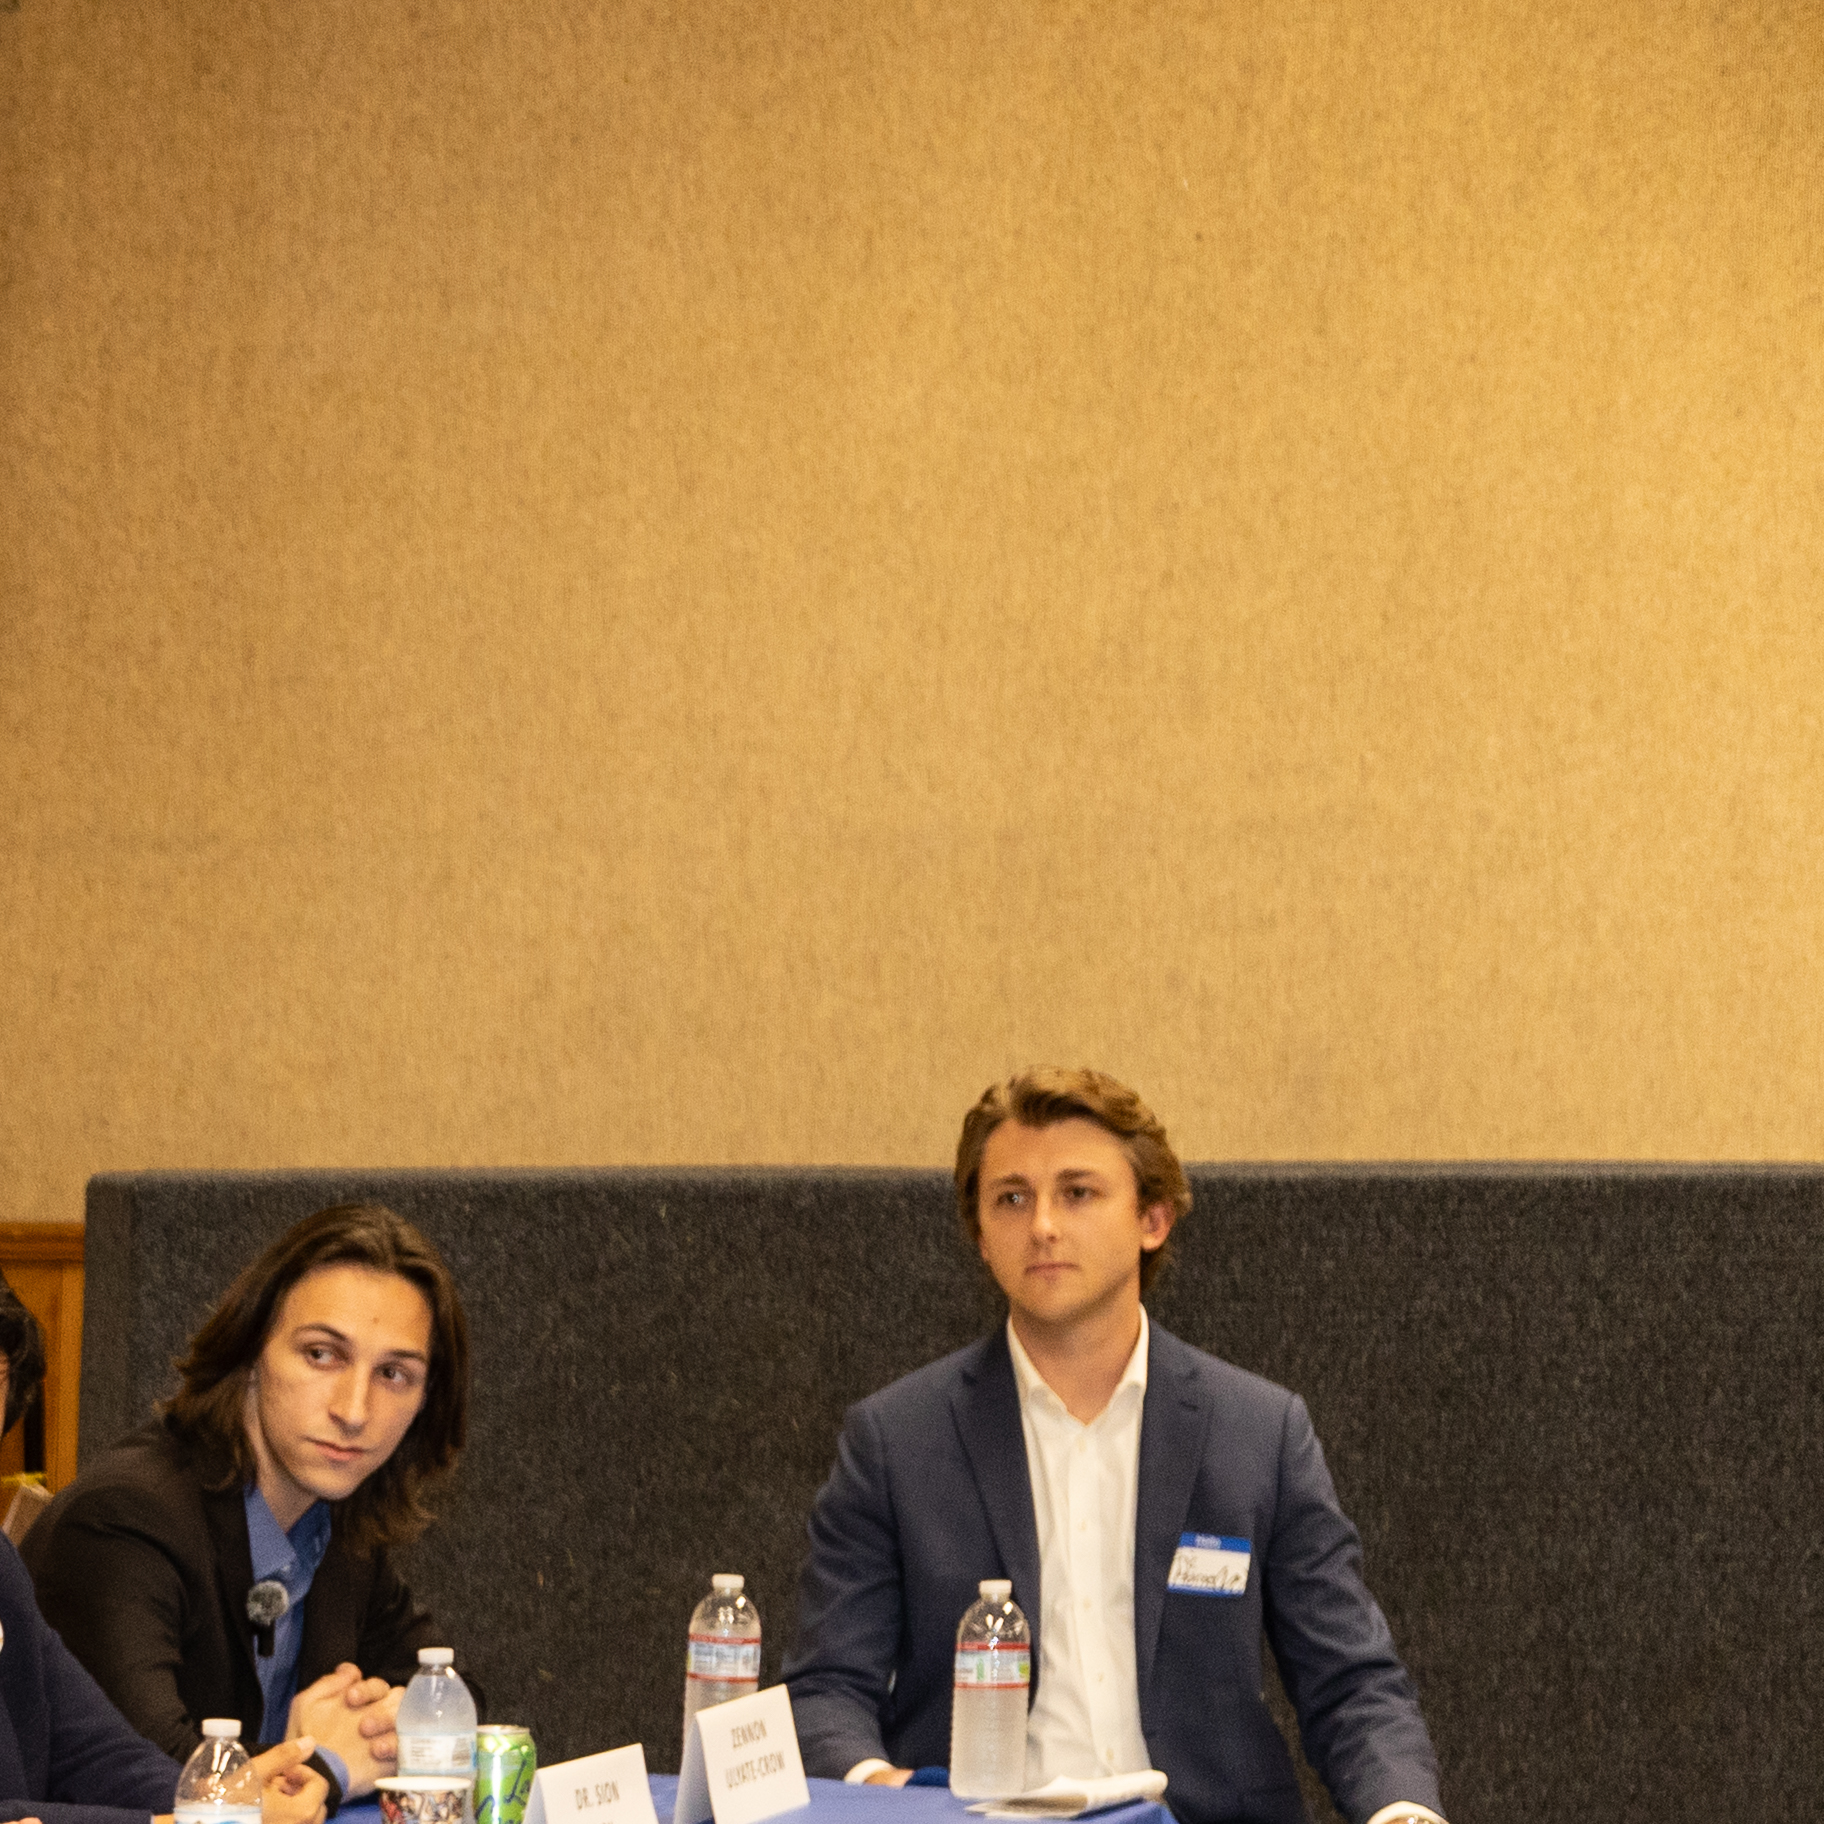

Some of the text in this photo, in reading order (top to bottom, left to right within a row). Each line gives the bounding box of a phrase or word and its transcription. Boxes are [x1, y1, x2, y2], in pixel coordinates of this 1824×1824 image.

[731, 1718, 767, 1750] ZENNON
[725, 1750, 786, 1790] ULYATE-CROW
[574, 1780, 620, 1810] DR. SION
